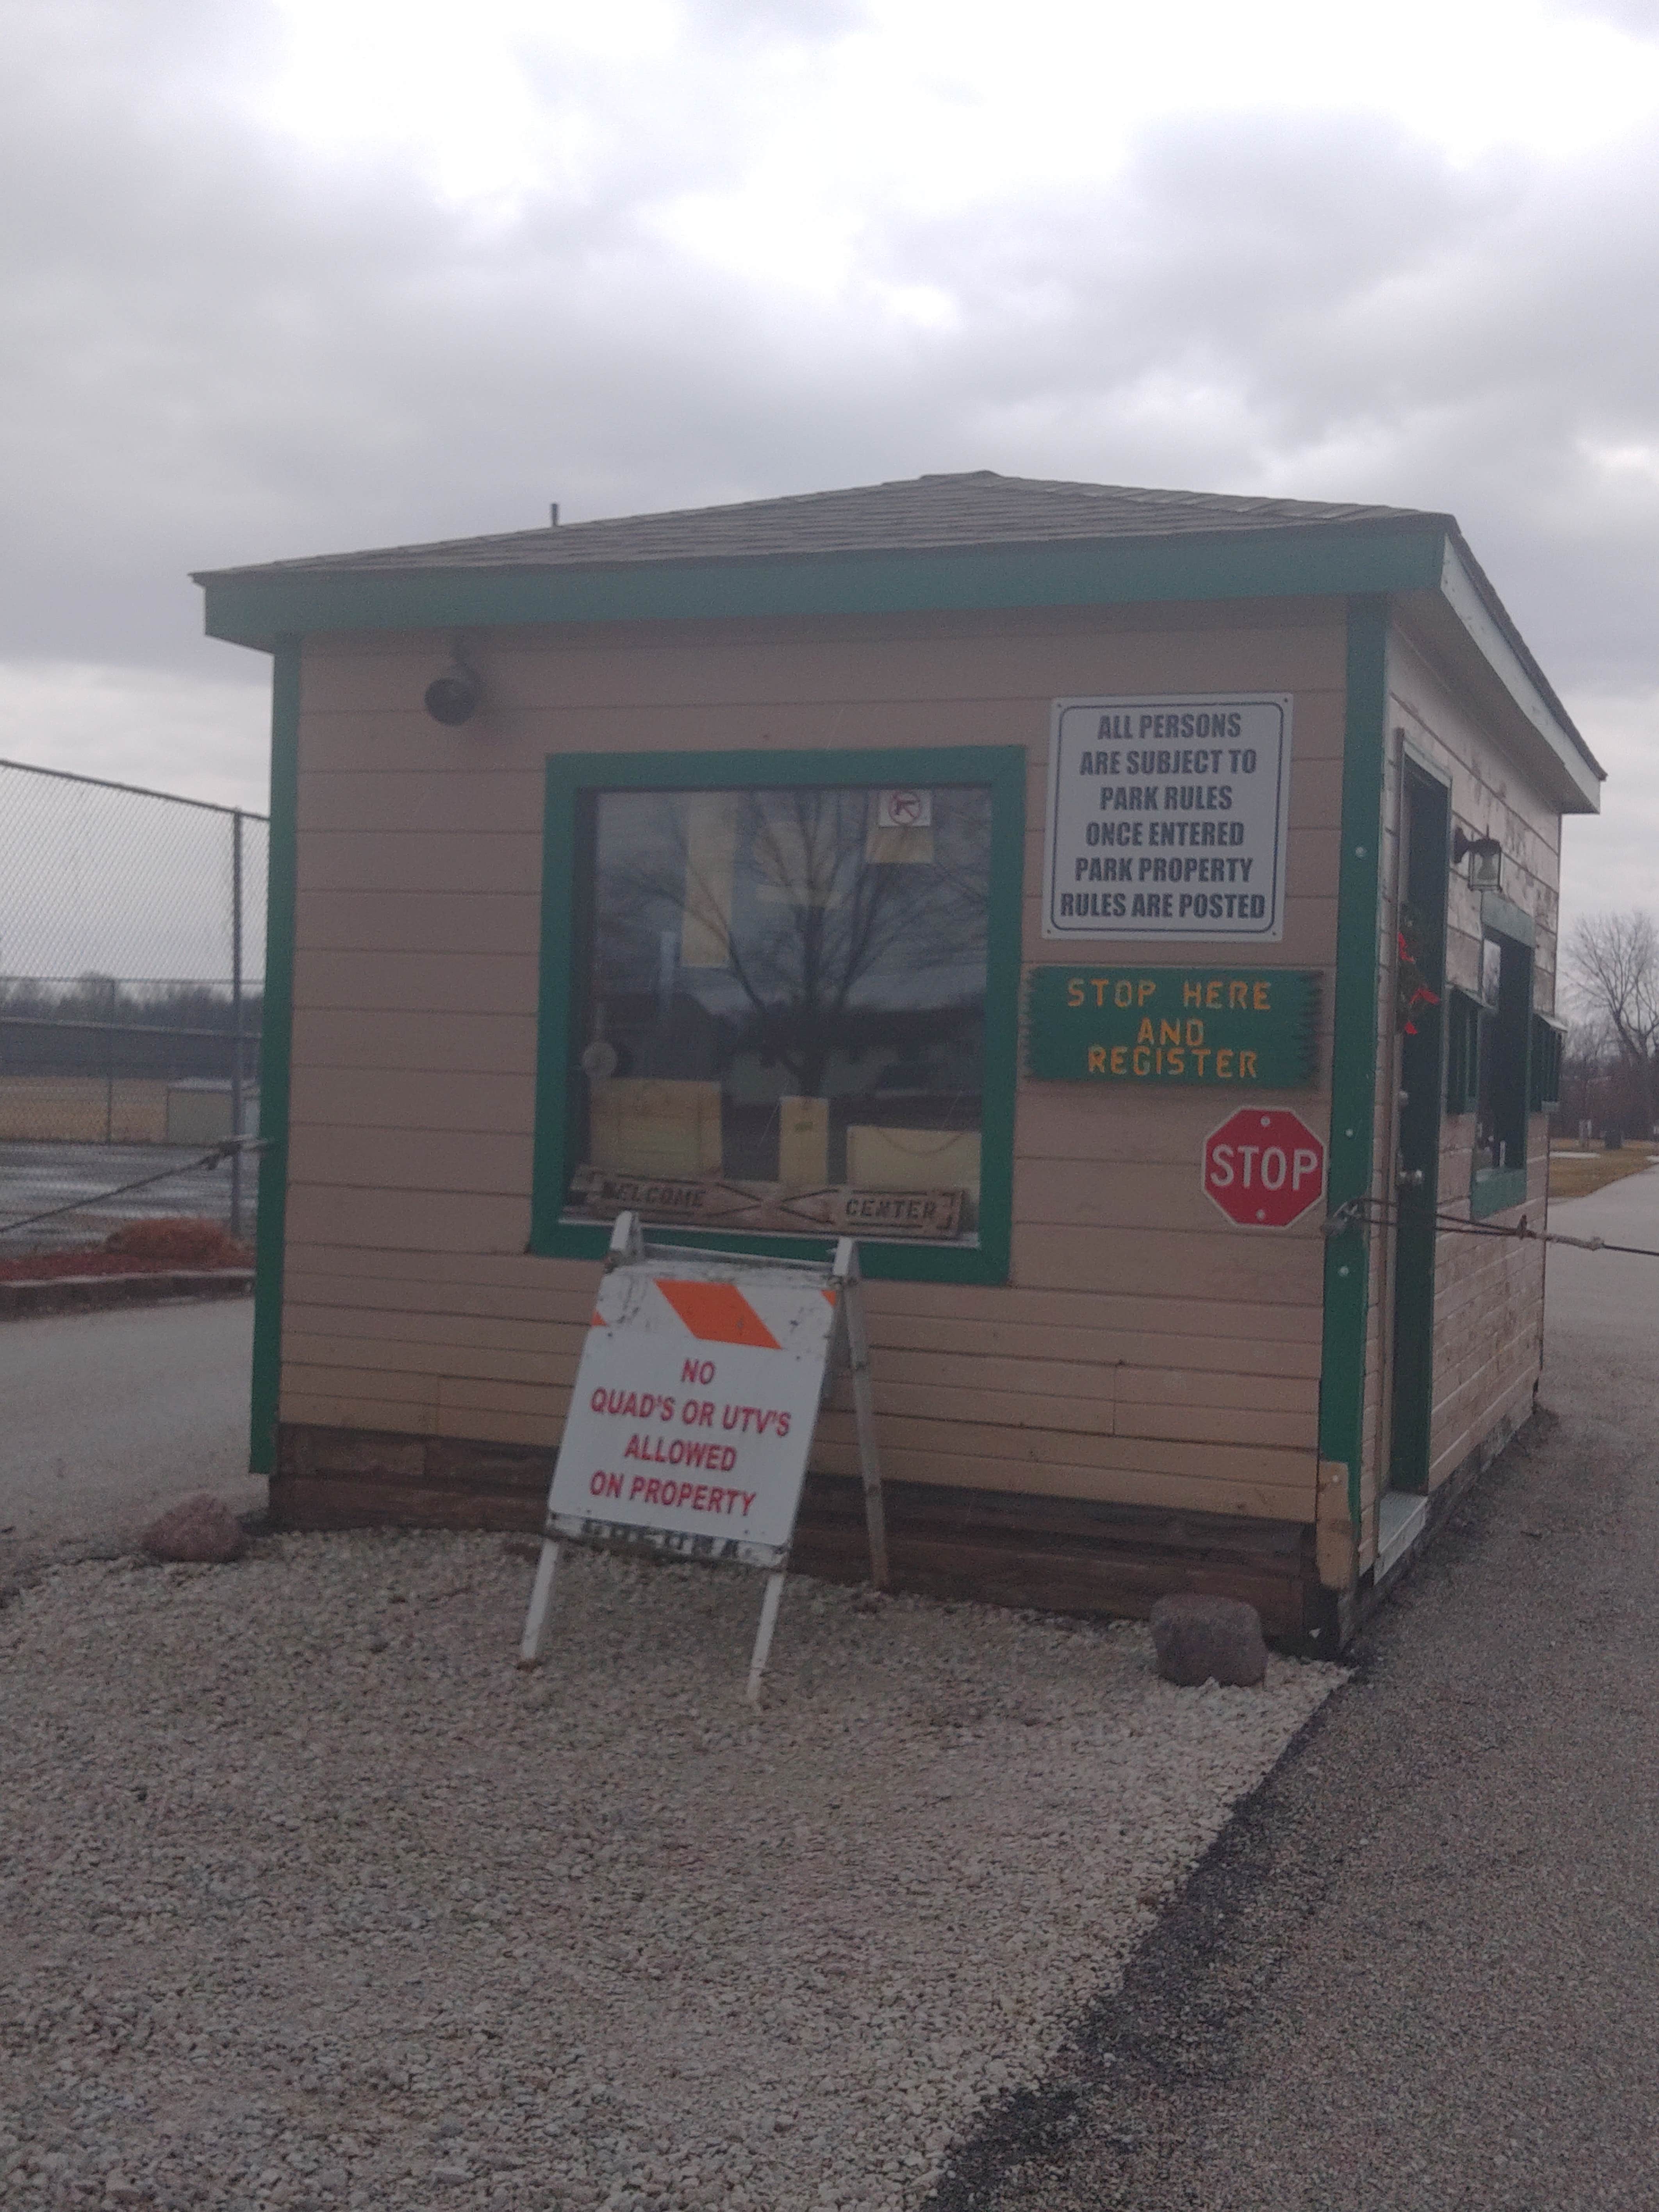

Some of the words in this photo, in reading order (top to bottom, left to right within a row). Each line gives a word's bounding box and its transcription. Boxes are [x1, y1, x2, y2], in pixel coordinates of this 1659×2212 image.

[1097, 715, 1133, 740] ALL
[1139, 712, 1241, 739] PERSONS
[1079, 751, 1120, 775] ARE
[1127, 749, 1222, 775] SUBJECT
[1229, 749, 1257, 773] TO
[1100, 786, 1158, 811] PARK
[1164, 786, 1232, 810] RULES
[1086, 822, 1143, 846] ONCE
[1149, 822, 1244, 847] ENTERED
[1075, 858, 1132, 882] PARK
[1138, 858, 1253, 882] PROPERTY
[1061, 893, 1126, 917] RULES
[1131, 893, 1172, 918] ARE
[1179, 893, 1265, 919] POSTED
[1067, 978, 1156, 1008] STOP
[1183, 980, 1271, 1010] HERE
[1137, 1017, 1205, 1046] AND
[1088, 1046, 1258, 1079] REGISTER
[1210, 1144, 1318, 1191] STOP
[846, 1198, 937, 1218] CENTER
[681, 1358, 715, 1385] NO
[590, 1387, 674, 1422] QUAD'S
[681, 1399, 714, 1428] OR
[722, 1405, 791, 1437] UTV'S
[624, 1434, 737, 1471] ALLOWED
[590, 1470, 624, 1498] ON
[629, 1475, 756, 1516] PROPERTY
